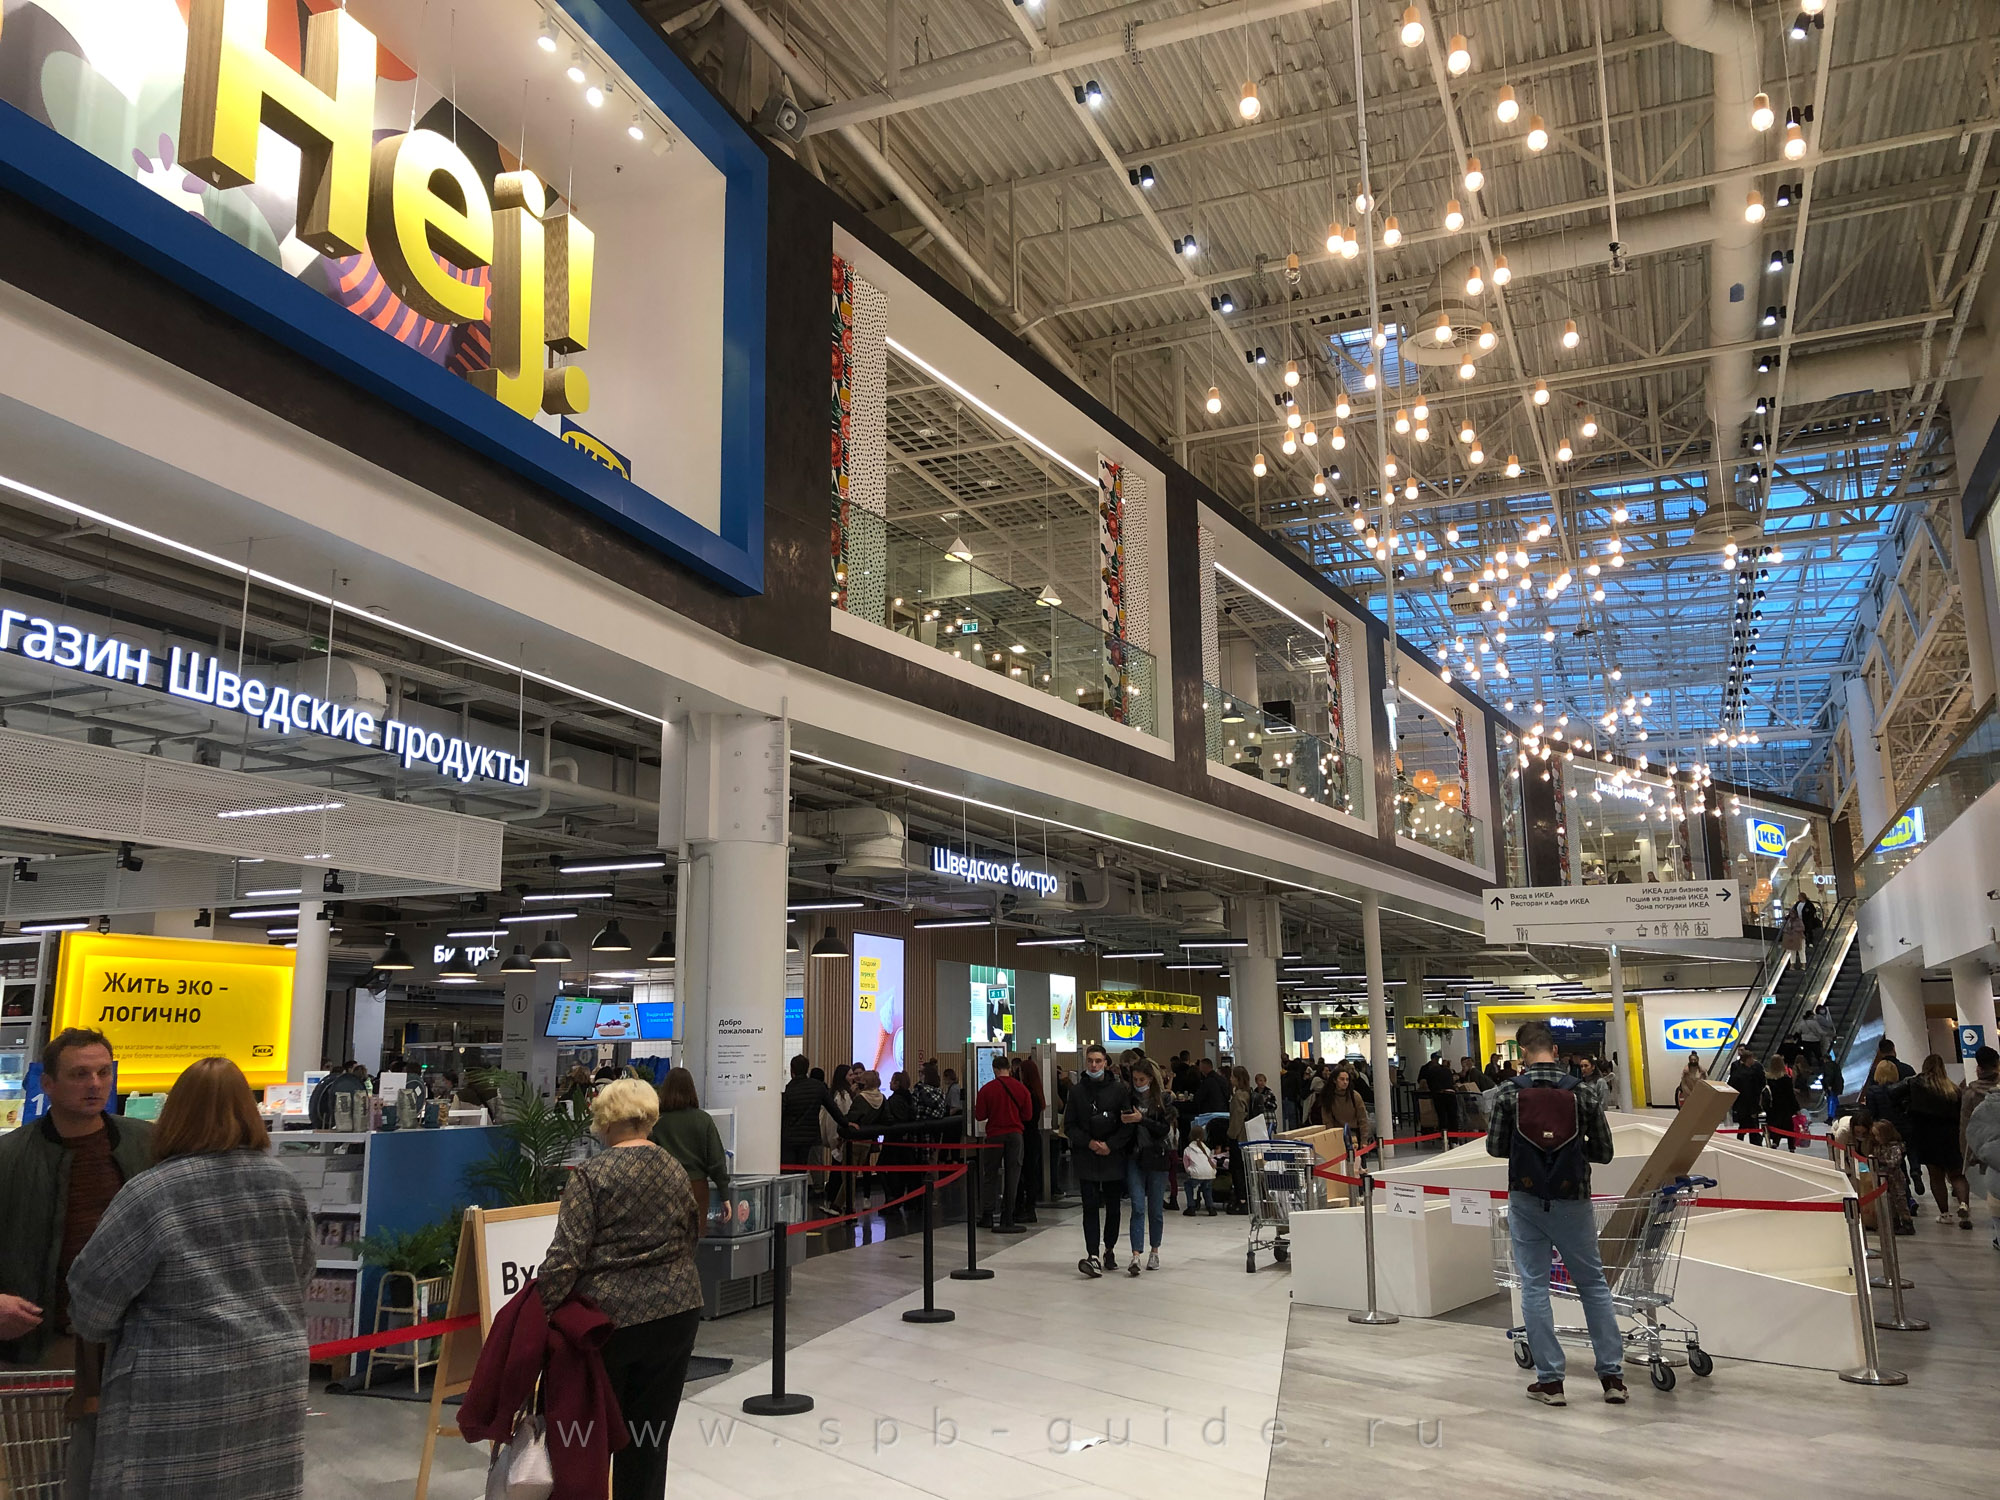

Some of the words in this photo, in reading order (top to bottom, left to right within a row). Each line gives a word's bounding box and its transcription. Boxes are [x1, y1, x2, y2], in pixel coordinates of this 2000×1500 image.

[178, 0, 595, 422] Hej!
[168, 646, 376, 746] Шведские
[384, 720, 530, 784] продукты
[1757, 829, 1784, 847] IKEA
[934, 846, 1009, 884] Шведское
[1011, 862, 1058, 898] бистро
[433, 944, 500, 966] Битр
[102, 972, 169, 993] Жить
[177, 979, 213, 996] эко
[98, 1006, 202, 1023] логично
[718, 1019, 742, 1027] Добро
[1550, 1016, 1574, 1029] Вход
[1673, 1027, 1734, 1040] IKEA
[502, 1261, 538, 1295] Вх
